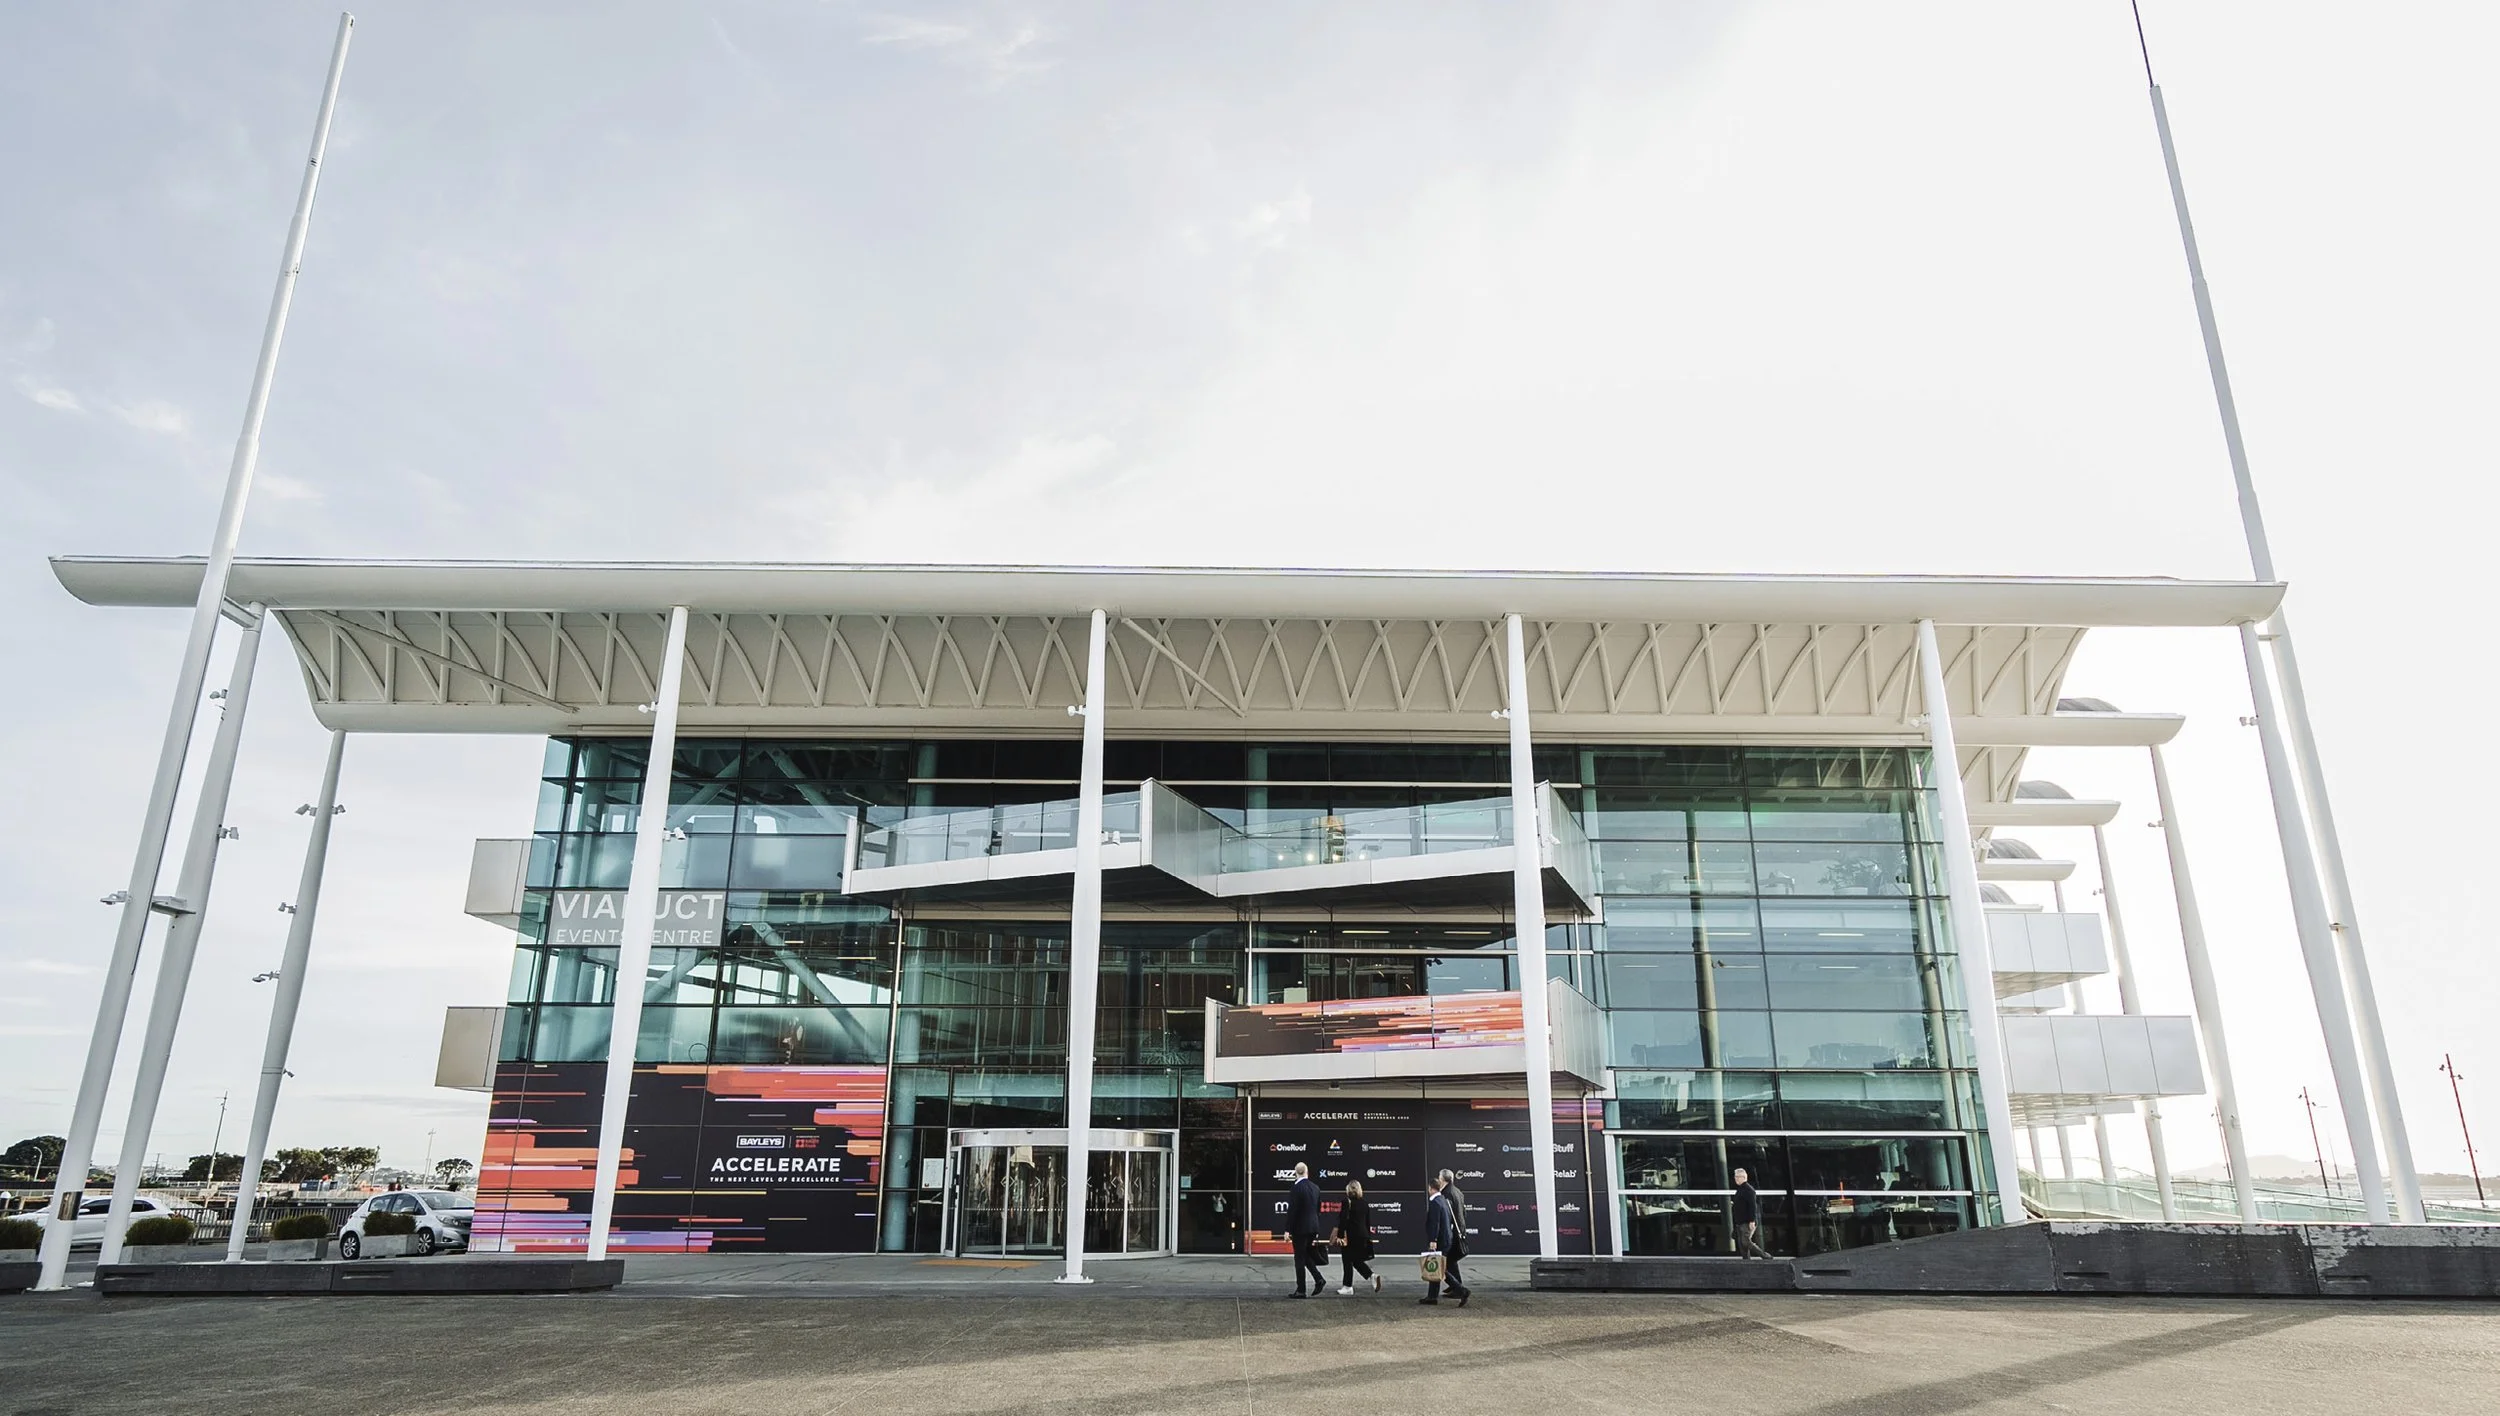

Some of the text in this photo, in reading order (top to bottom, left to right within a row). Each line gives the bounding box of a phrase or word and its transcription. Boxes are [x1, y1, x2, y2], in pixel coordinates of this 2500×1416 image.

[557, 893, 724, 920] VIAUCT
[651, 930, 713, 944] ENTRE
[1304, 1112, 1358, 1120] ACCELERATE
[739, 1137, 782, 1146] BAYLEYS
[1276, 1143, 1307, 1152] OneRoof
[1553, 1143, 1574, 1153] Stuff
[711, 1157, 841, 1172] ACCELERATE
[1273, 1169, 1296, 1178] JAZZ
